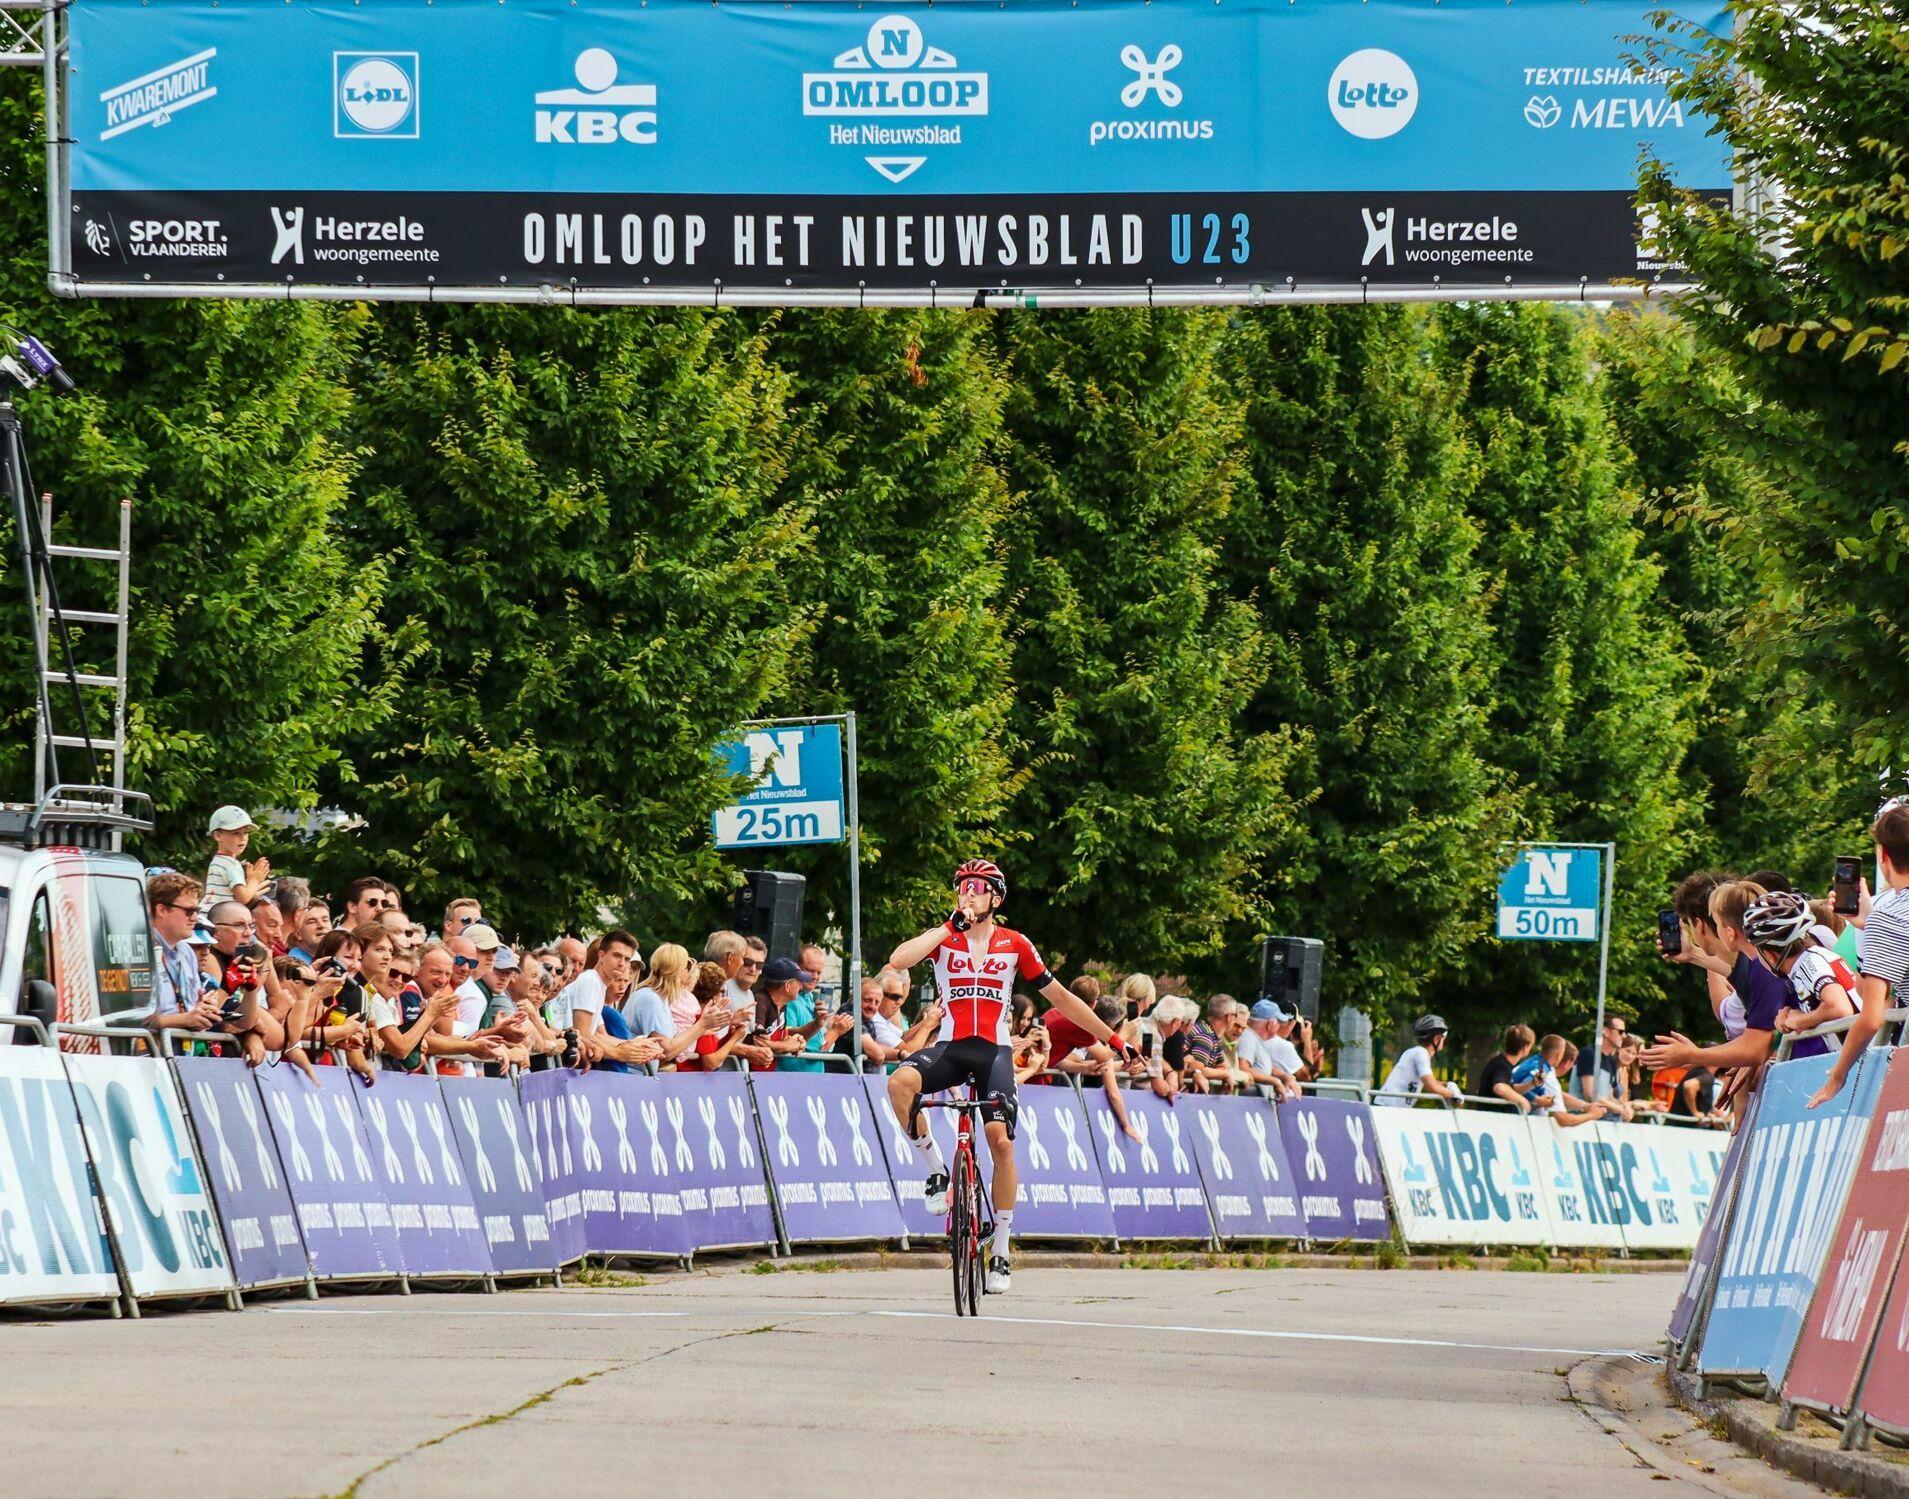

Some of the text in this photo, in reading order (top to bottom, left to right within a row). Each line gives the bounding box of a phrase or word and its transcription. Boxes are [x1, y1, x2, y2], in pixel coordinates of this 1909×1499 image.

[881, 29, 910, 56] N
[107, 61, 209, 126] KWAREMONT
[809, 80, 980, 108] OMLOOP
[535, 110, 657, 144] KBC
[1570, 98, 1684, 129] MEWA
[829, 124, 962, 145] Het Nieuwsblad
[1090, 120, 1214, 146] proximus
[129, 220, 228, 242] SPORT.
[315, 216, 424, 241] Herzele
[524, 213, 1250, 267] OMLOOP HET NIEUWSBLAD U23
[1407, 216, 1518, 241] Herzele
[129, 242, 227, 257] VLAANDEREN
[313, 248, 440, 265] woongemeente
[1405, 248, 1534, 265] woongemeente
[744, 731, 804, 788] N
[761, 788, 807, 799] Nieuwsblad
[736, 807, 819, 841] 25m
[1524, 852, 1572, 896] N
[1516, 910, 1578, 936] 50m
[949, 987, 1003, 1001] SOUDAL
[0, 1077, 181, 1275] KBC
[1423, 1131, 1511, 1222] KBC
[1574, 1140, 1653, 1226] KBC
[1409, 1188, 1437, 1218] KBC
[1516, 1192, 1539, 1220] KBC
[1558, 1194, 1582, 1222] KBC
[1656, 1198, 1679, 1224] KBC
